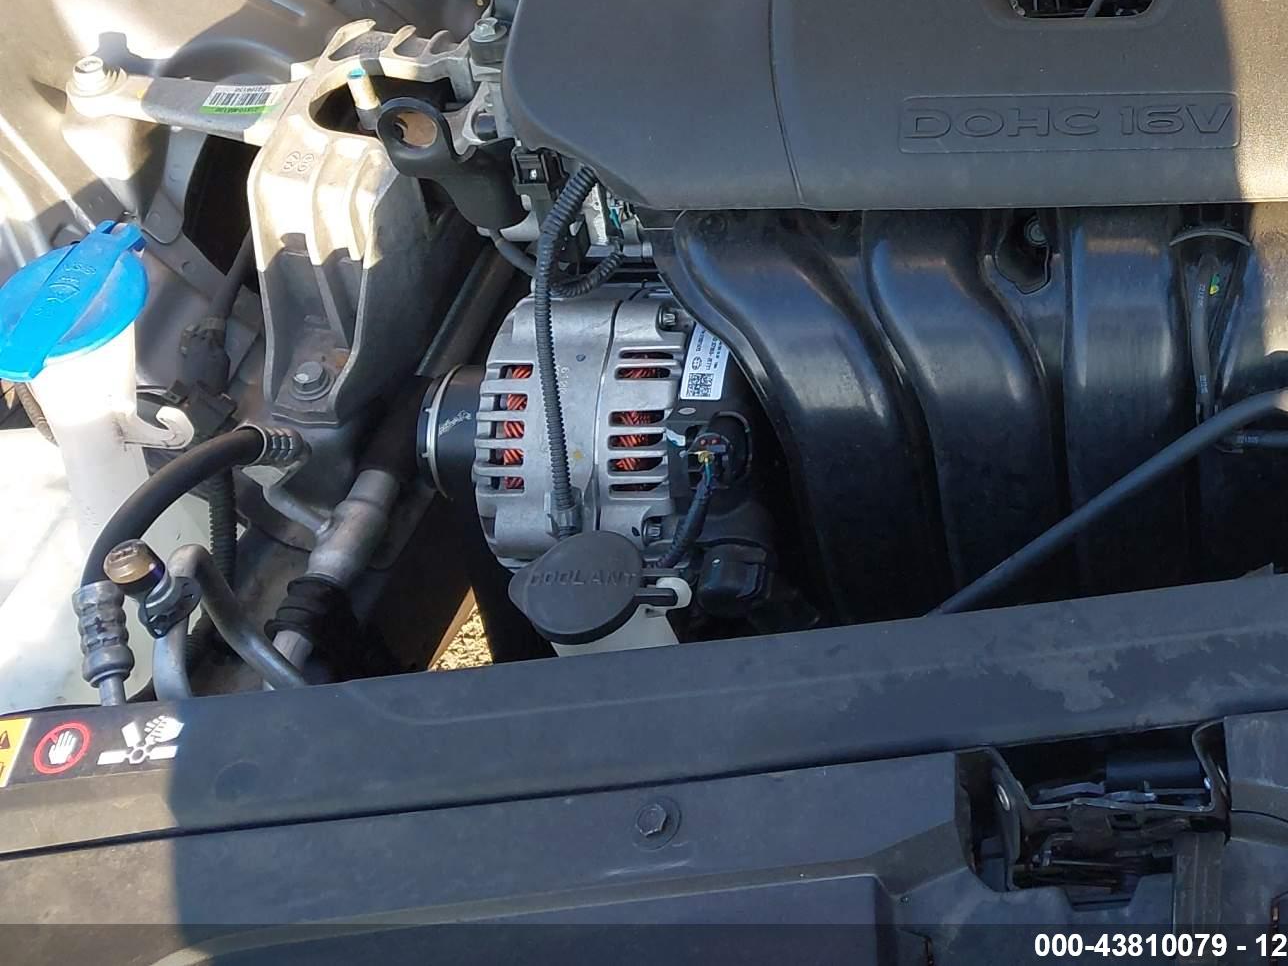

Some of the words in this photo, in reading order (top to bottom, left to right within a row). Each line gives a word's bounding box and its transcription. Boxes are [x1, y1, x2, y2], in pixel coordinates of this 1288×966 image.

[903, 106, 1101, 138] DOHC
[1118, 104, 1233, 135] 16V
[529, 569, 637, 586] COOLANT
